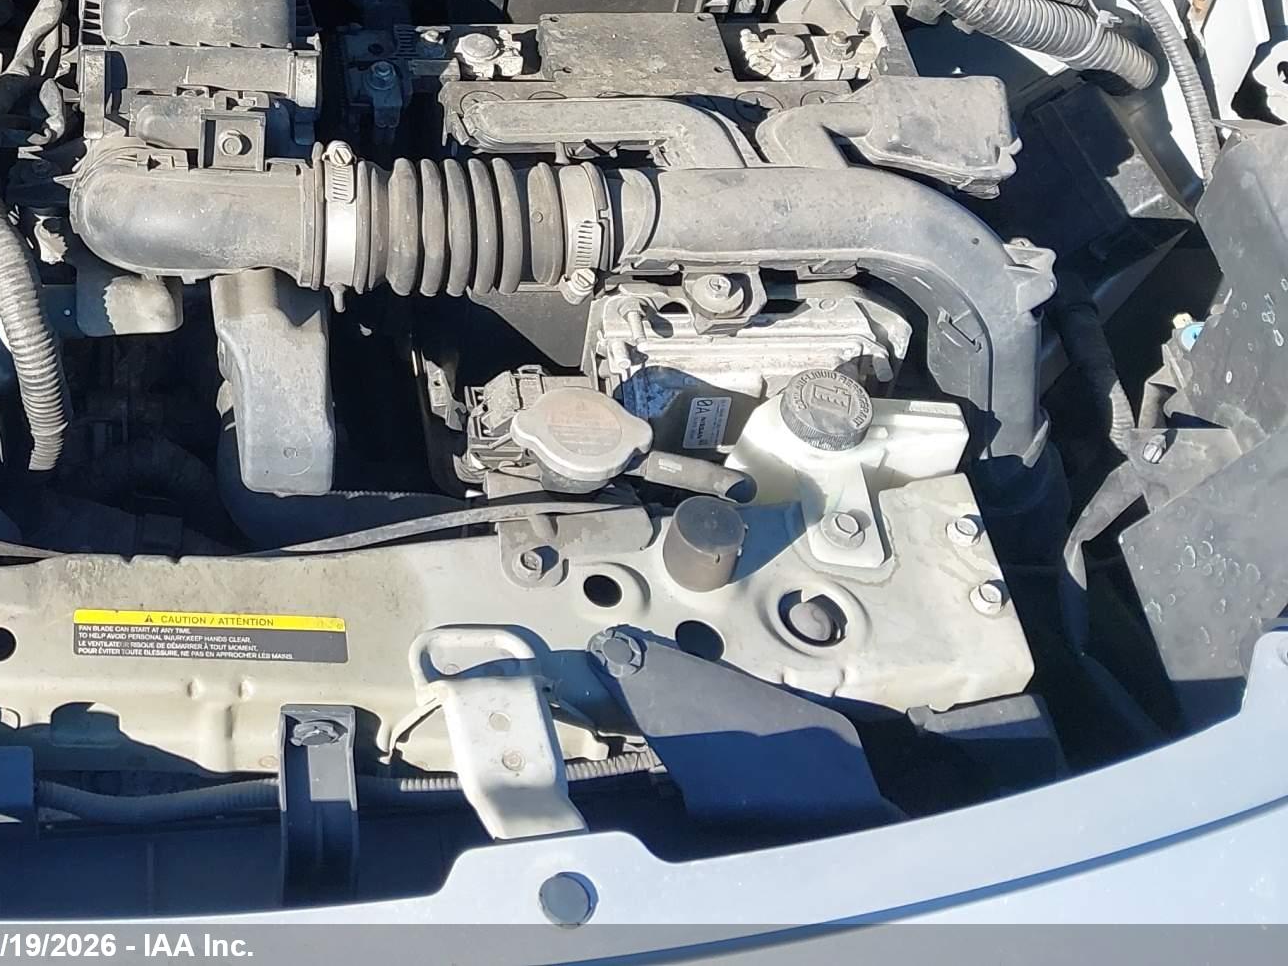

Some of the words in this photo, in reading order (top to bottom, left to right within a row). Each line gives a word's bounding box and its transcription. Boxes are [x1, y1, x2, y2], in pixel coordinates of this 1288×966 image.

[160, 614, 207, 625] CAUTION
[217, 617, 274, 627] ATTENTION
[78, 625, 92, 633] FAN
[130, 626, 151, 634] START
[128, 633, 162, 641] PERSONAL
[87, 640, 130, 648] VENTILATEUR
[130, 641, 156, 649] RISQUE
[209, 643, 228, 651] TOUT
[98, 646, 121, 655] ÉVITER
[216, 651, 257, 659] APPROCHER
